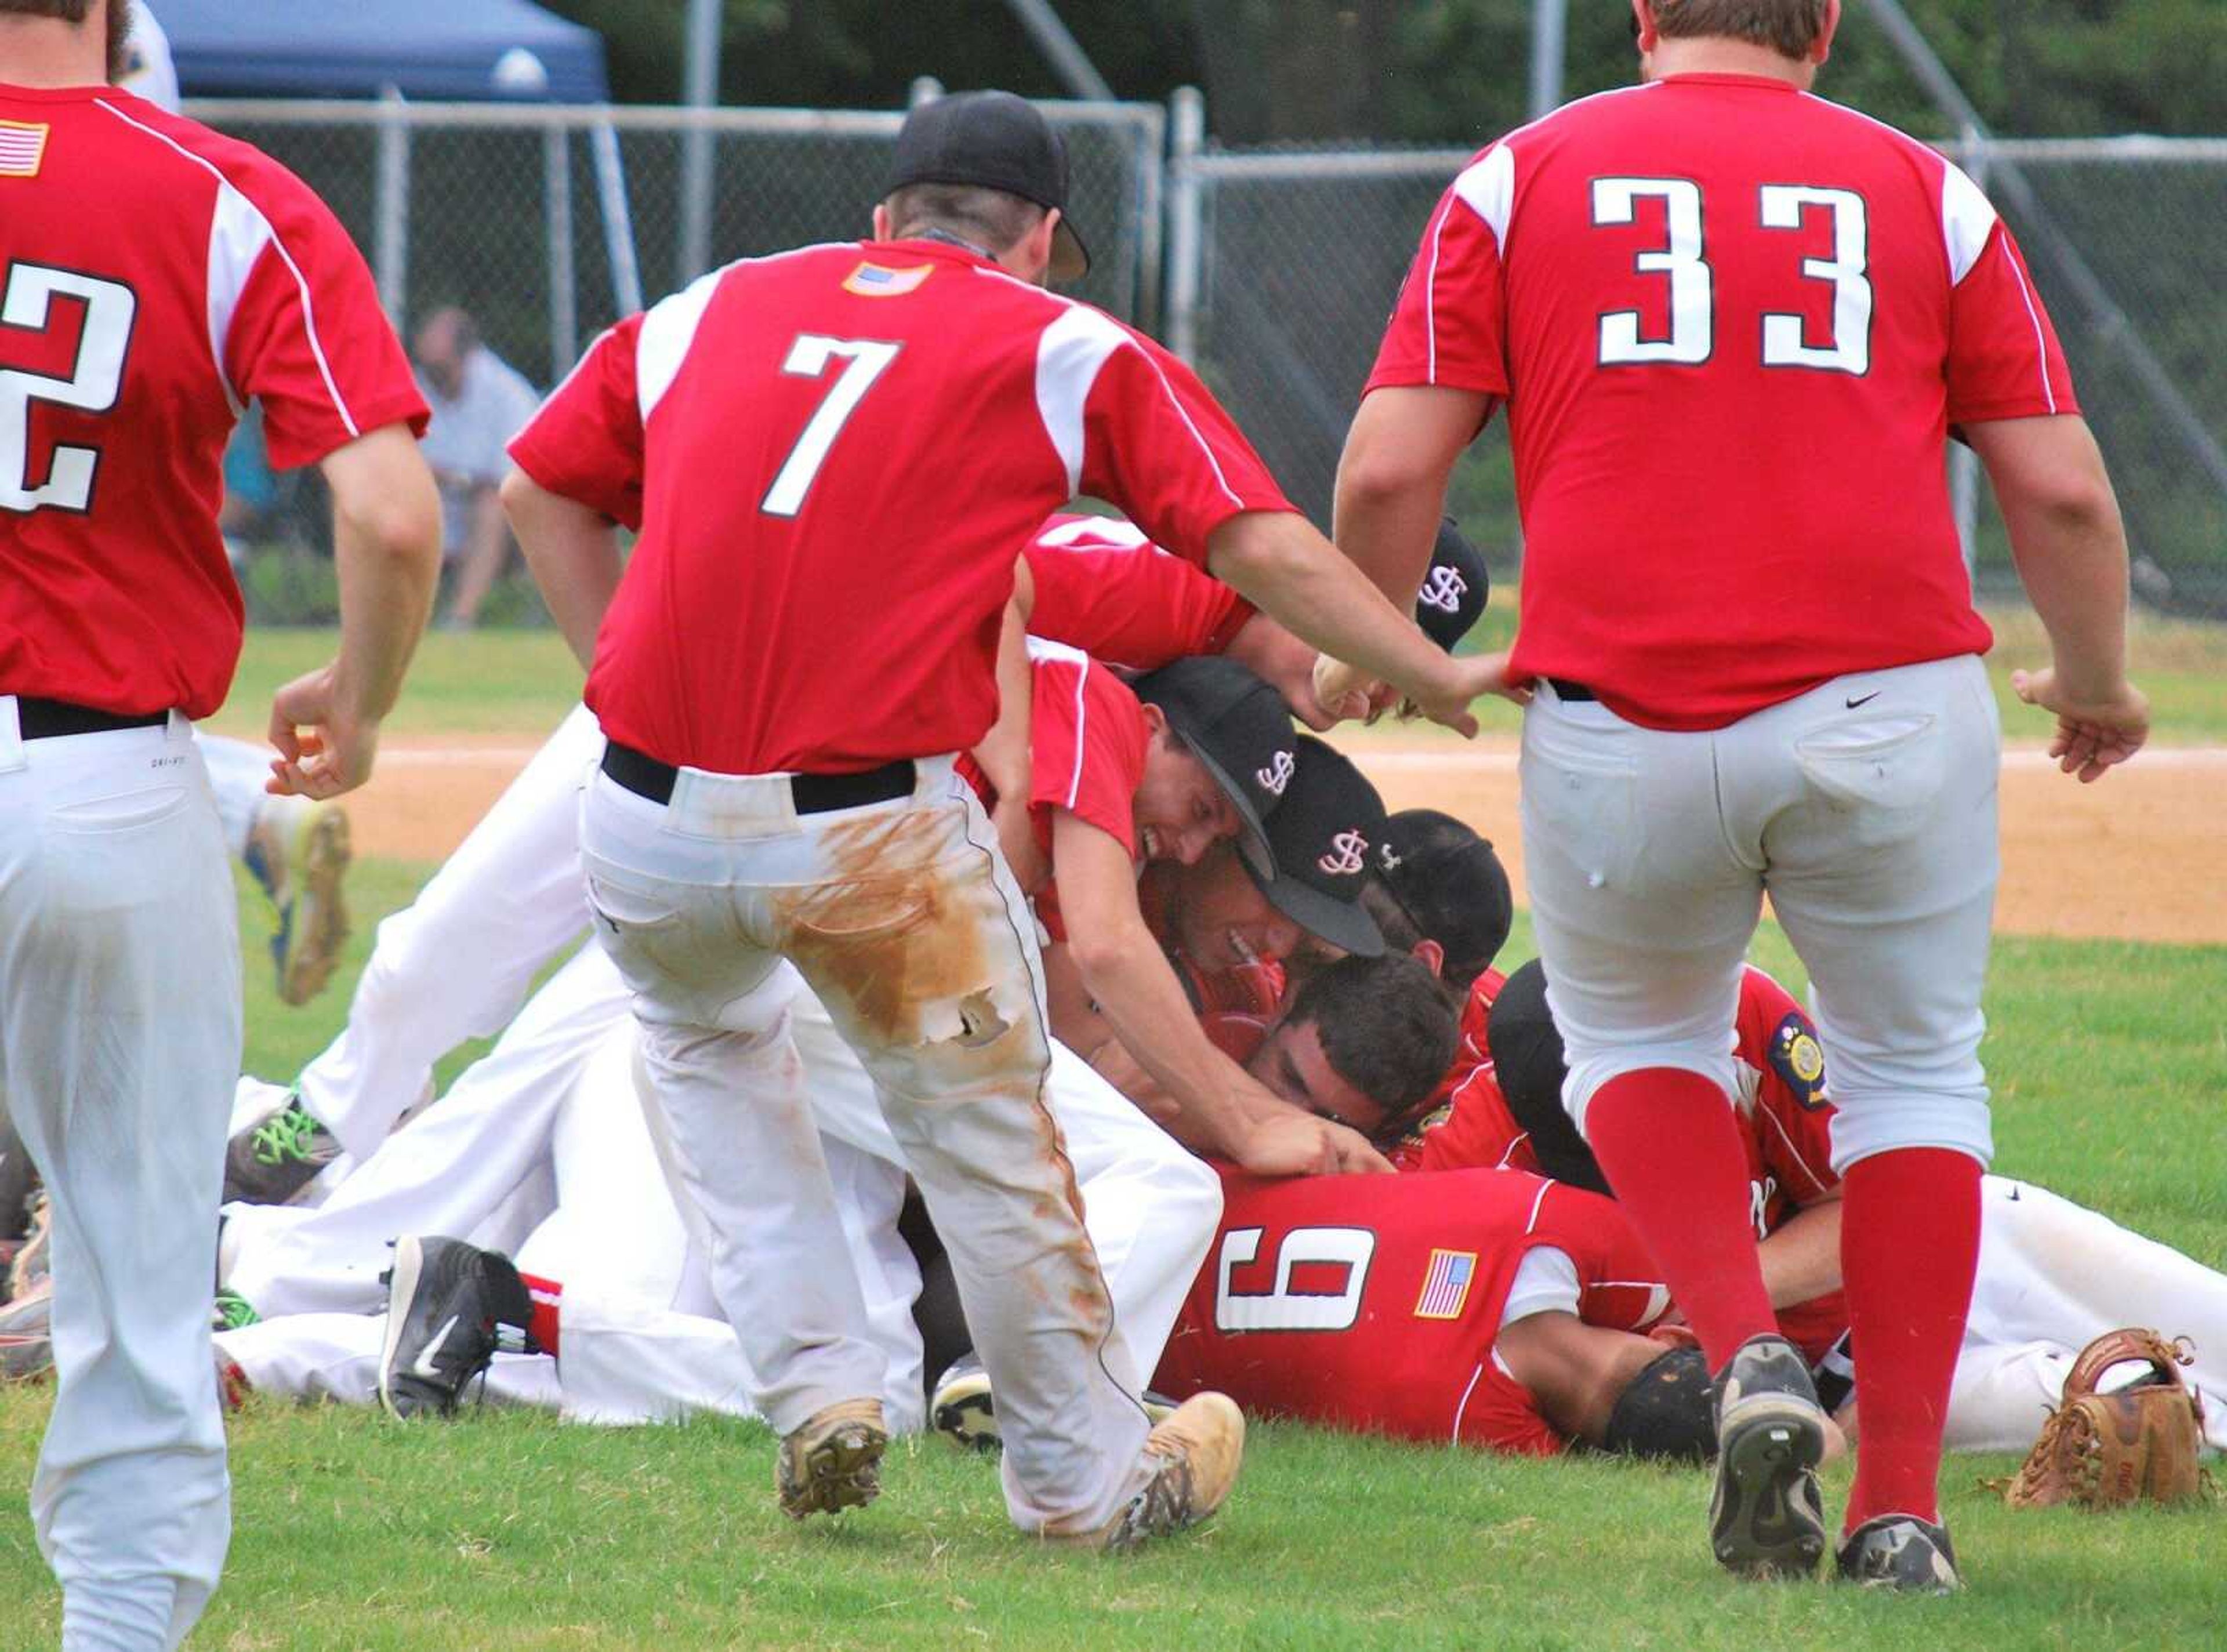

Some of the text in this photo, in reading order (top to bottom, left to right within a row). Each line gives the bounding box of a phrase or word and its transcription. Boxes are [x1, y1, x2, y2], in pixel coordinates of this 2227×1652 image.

[1590, 177, 1875, 378] 33
[761, 332, 904, 519] 7
[1215, 1226, 1377, 1333] 6
